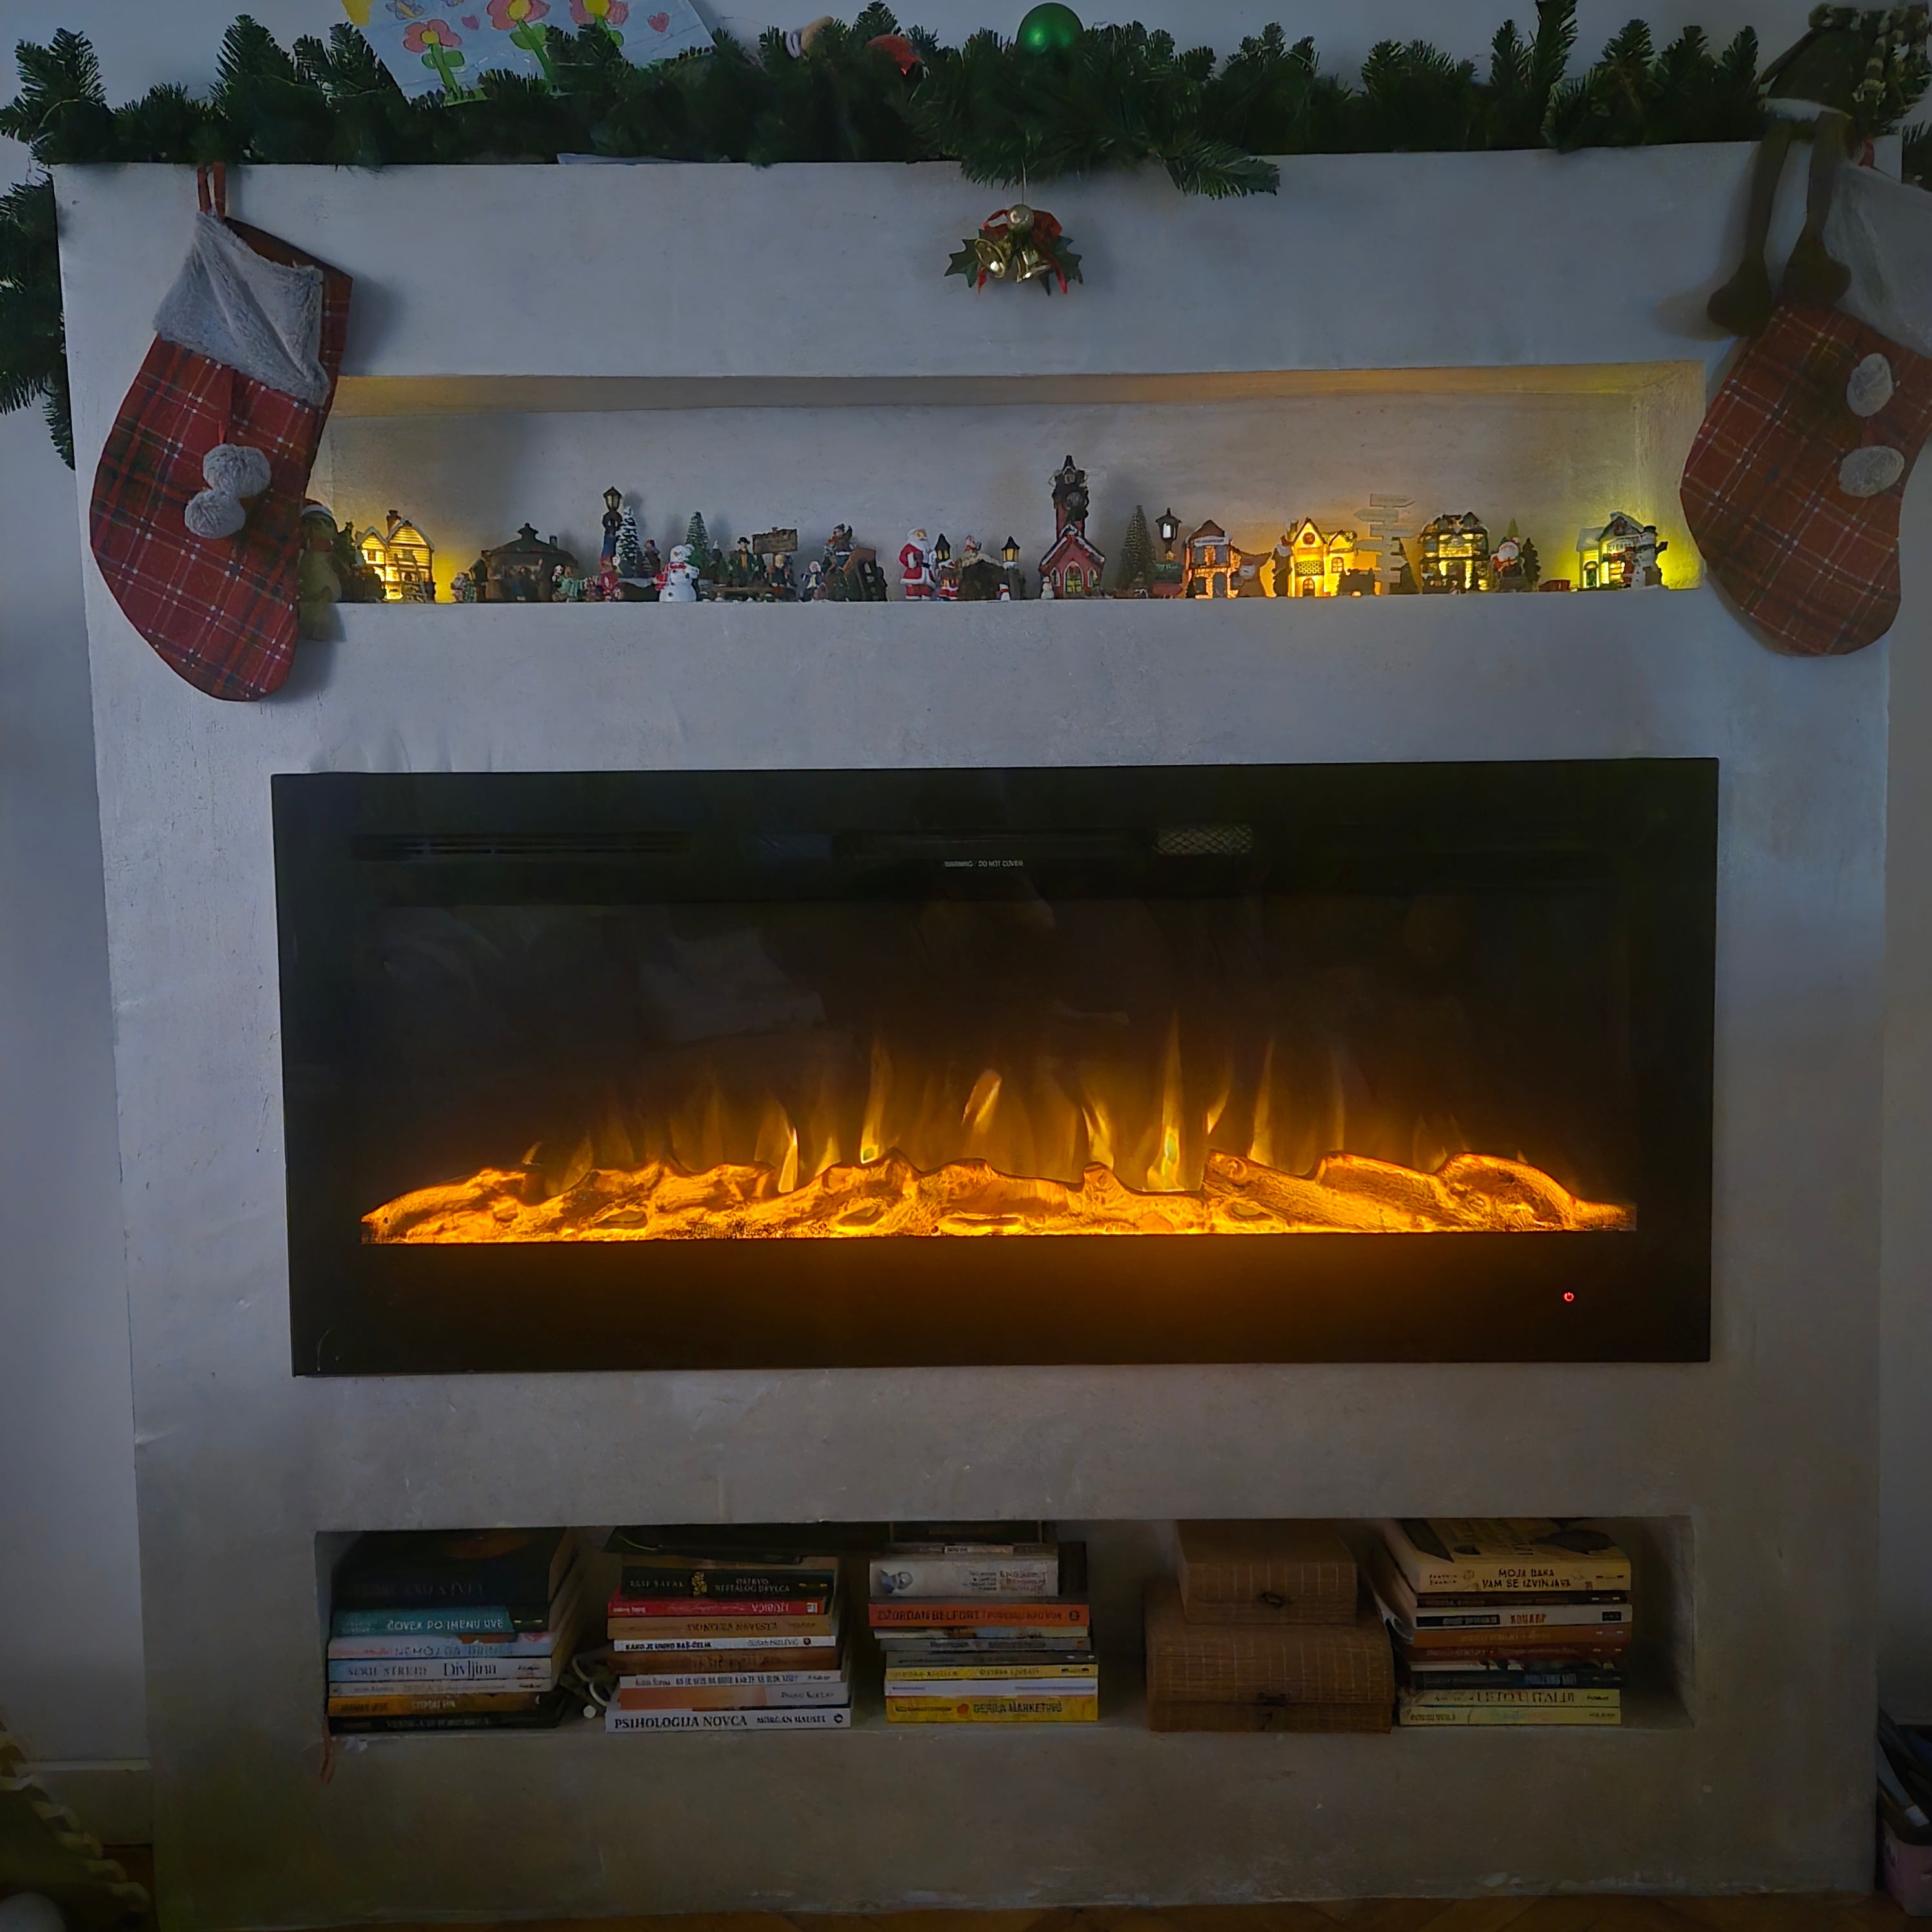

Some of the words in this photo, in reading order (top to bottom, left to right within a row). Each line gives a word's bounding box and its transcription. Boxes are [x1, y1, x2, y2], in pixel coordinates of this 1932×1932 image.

[1498, 1568, 1526, 1577] MOJA
[1530, 1568, 1555, 1577] BAKA
[1483, 1579, 1502, 1588] VAM
[1506, 1579, 1519, 1588] SE
[932, 1610, 980, 1620] BELFORT
[387, 1619, 422, 1630] ČOVEK
[427, 1619, 443, 1630] PO
[447, 1619, 480, 1630] IMENU
[444, 1661, 497, 1678] Divljina
[614, 1717, 699, 1729] PSIHOLOGIJA
[703, 1715, 748, 1727] NOVCA
